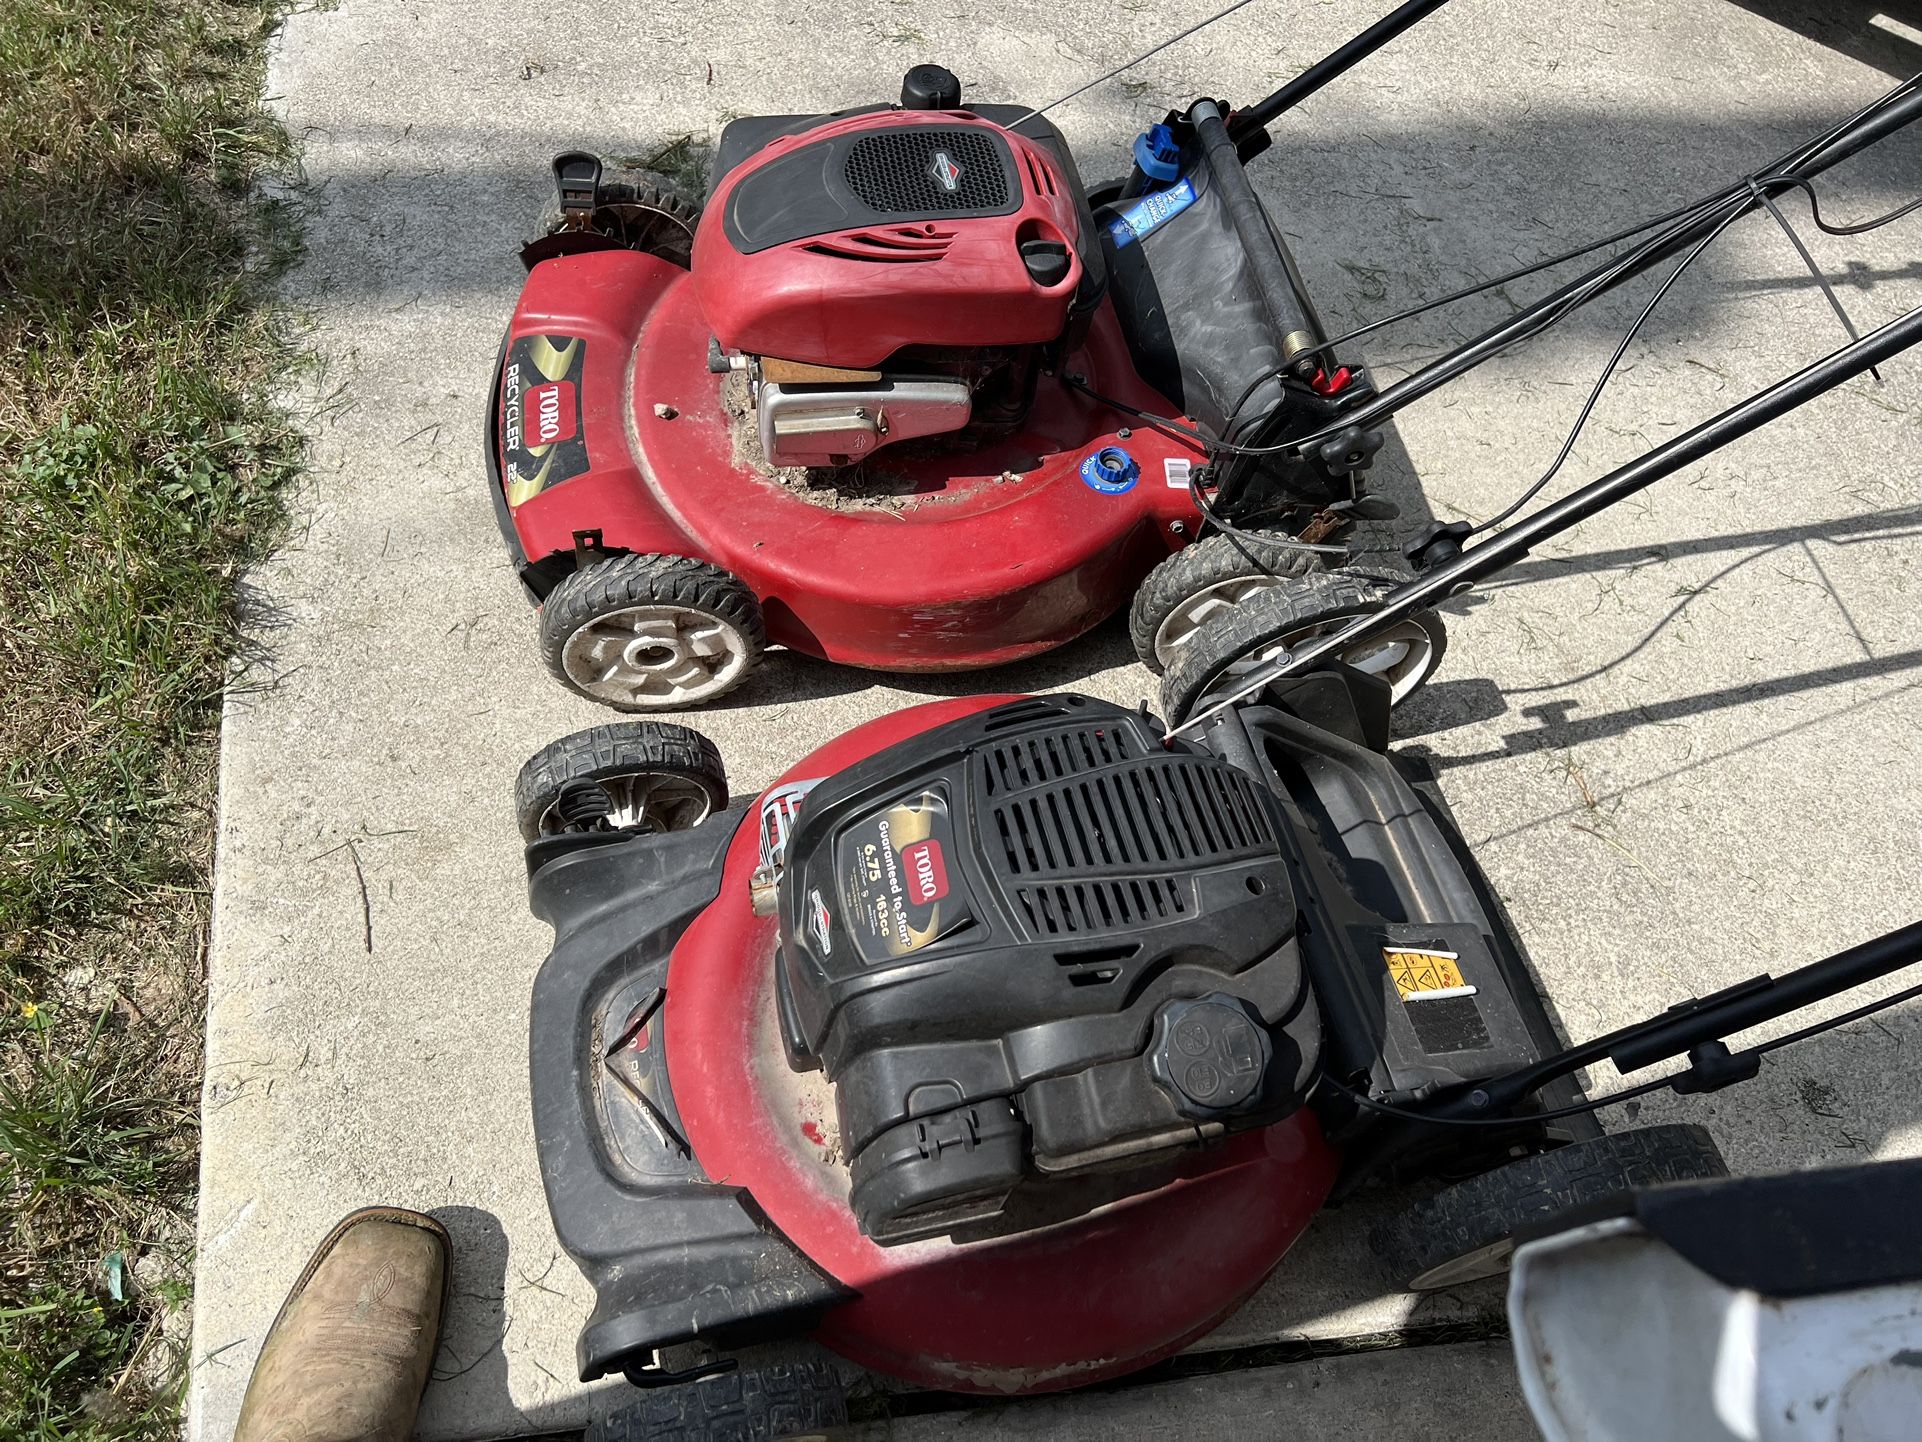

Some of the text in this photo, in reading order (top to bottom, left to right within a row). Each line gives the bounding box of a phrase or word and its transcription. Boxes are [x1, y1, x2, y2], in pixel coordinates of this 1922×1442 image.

[506, 363, 520, 451] RECYCLER
[539, 386, 560, 439] TORO
[1081, 455, 1096, 475] QUICK
[878, 820, 903, 895] Guaranteed
[914, 846, 937, 898] TORO
[864, 843, 890, 937] 6.75 163cc
